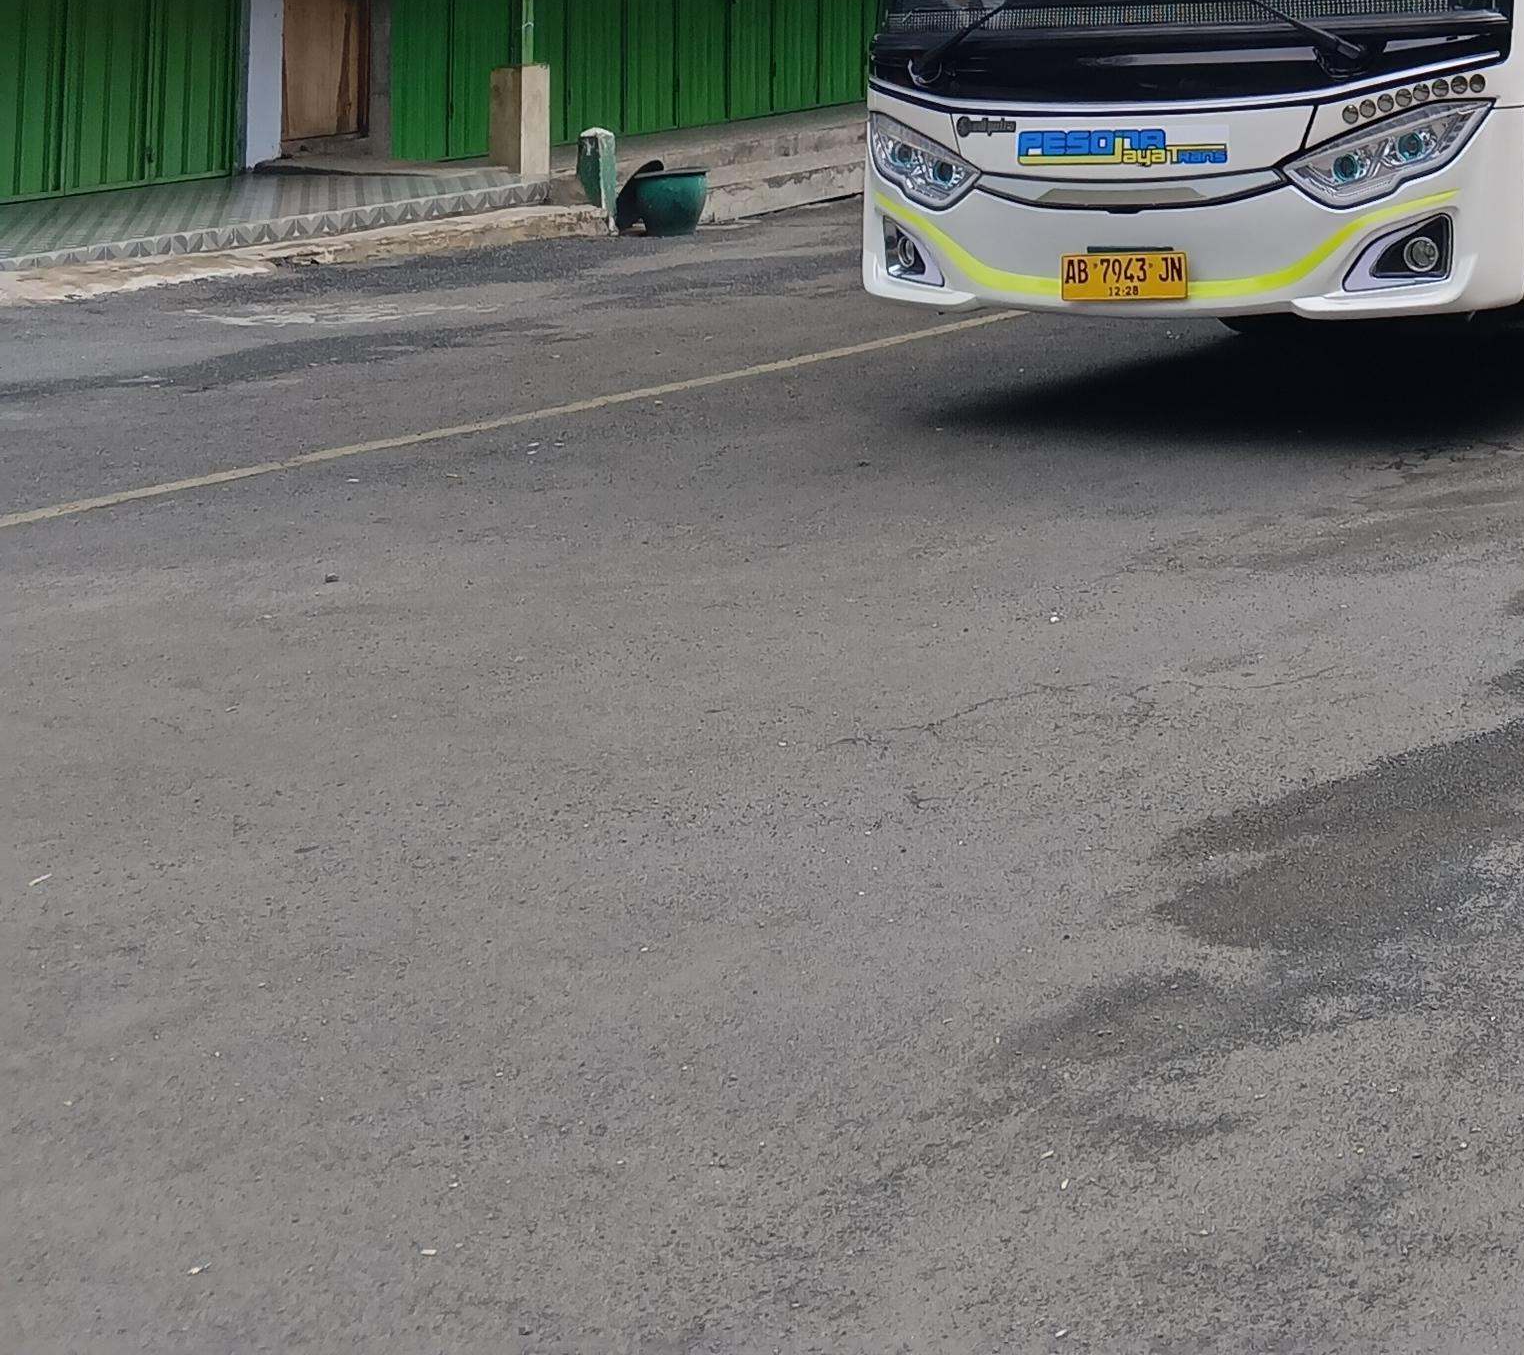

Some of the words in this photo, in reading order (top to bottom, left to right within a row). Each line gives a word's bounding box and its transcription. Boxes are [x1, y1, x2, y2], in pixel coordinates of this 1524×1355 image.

[1018, 129, 1166, 155] PESONA
[1065, 259, 1089, 284] AB
[1099, 257, 1147, 283] 7943
[1158, 256, 1183, 282] JN
